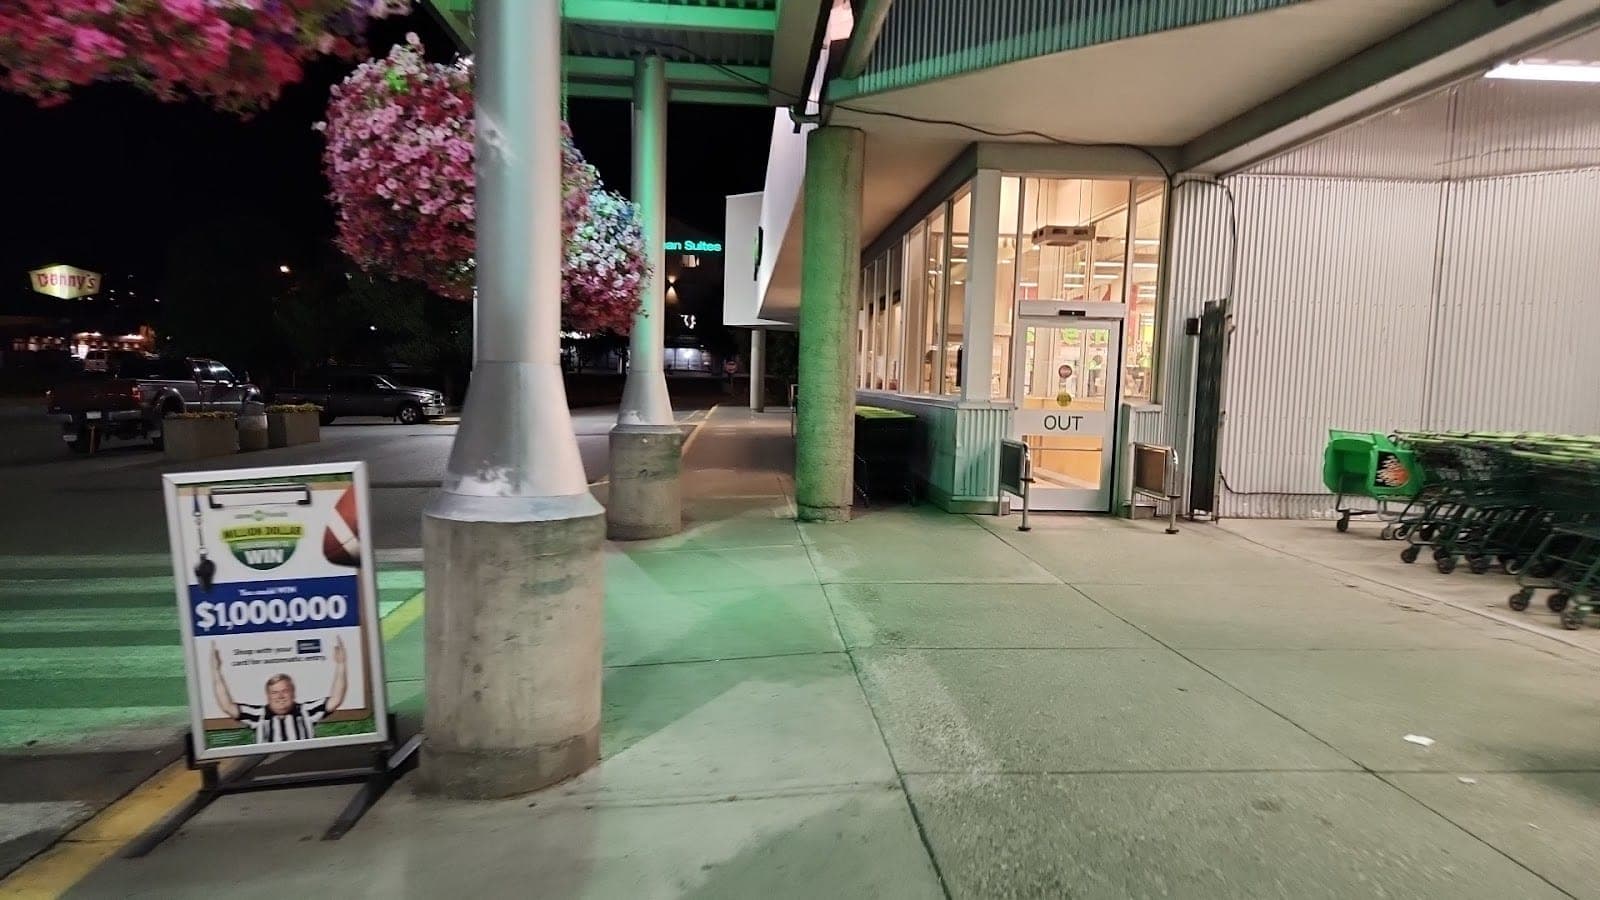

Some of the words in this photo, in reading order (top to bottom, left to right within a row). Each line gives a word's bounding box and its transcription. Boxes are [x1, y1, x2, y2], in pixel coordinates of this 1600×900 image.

[664, 241, 682, 250] an
[684, 240, 721, 251] Suites
[37, 273, 96, 290] Denny's
[1044, 414, 1084, 431] OUT
[244, 549, 284, 564] WIN
[195, 595, 347, 631] $1,000,000
